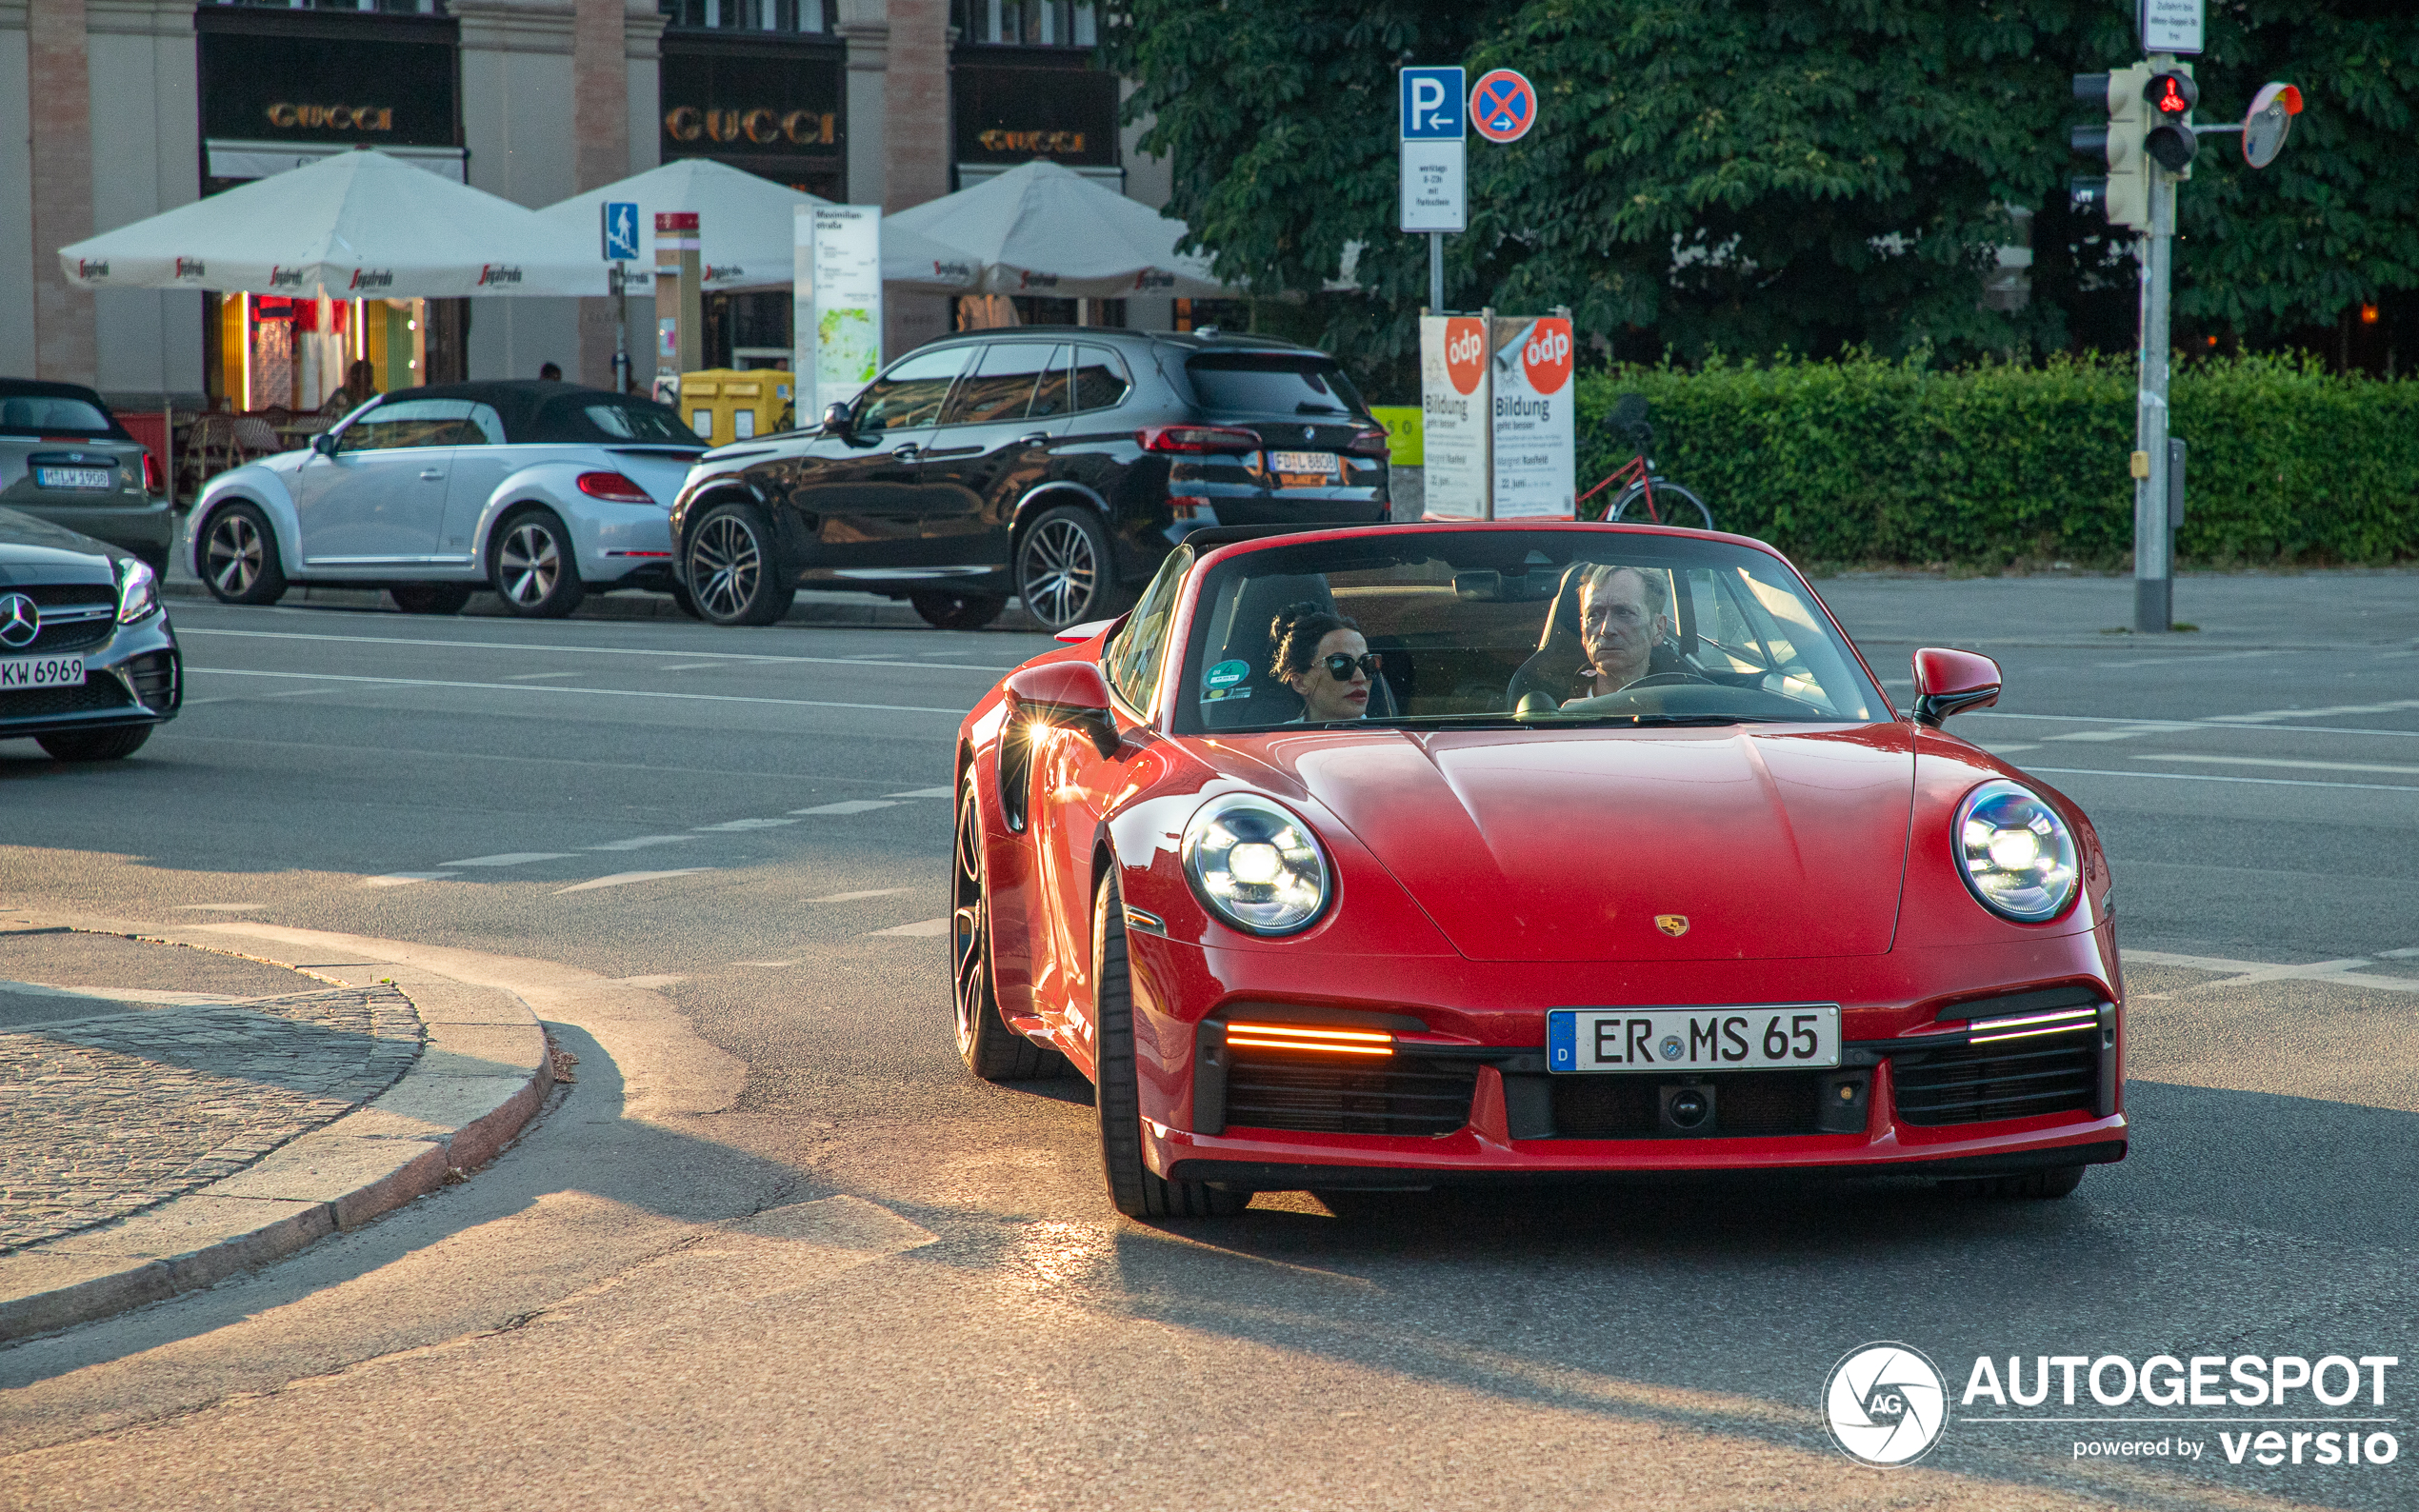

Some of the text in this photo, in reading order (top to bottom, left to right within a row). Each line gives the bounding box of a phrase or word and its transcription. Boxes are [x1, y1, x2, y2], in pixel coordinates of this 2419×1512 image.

[1411, 78, 1446, 130] P
[268, 103, 392, 130] GUCCI
[666, 107, 834, 144] GUCCI
[979, 129, 1085, 153] GUCCI
[80, 258, 110, 278] Segafredo
[176, 257, 206, 278] Segafredo
[269, 265, 304, 288] Segafredo
[349, 268, 393, 290] Segafredo
[477, 264, 523, 286] Segafredo
[703, 264, 744, 281] Segafredo
[1449, 328, 1482, 366] ödp
[1527, 328, 1569, 366] ödp
[1426, 393, 1468, 422] Bildung
[1495, 395, 1550, 422] Bildung
[1496, 421, 1535, 432] geht besser
[1276, 453, 1291, 468] FD
[1298, 453, 1306, 468] L
[45, 470, 53, 484] M
[61, 470, 76, 484] LW
[2, 660, 82, 685] KW 6969
[1222, 664, 1232, 675] 4
[1594, 1014, 1818, 1064] ER MS 65
[1557, 1048, 1568, 1062] D
